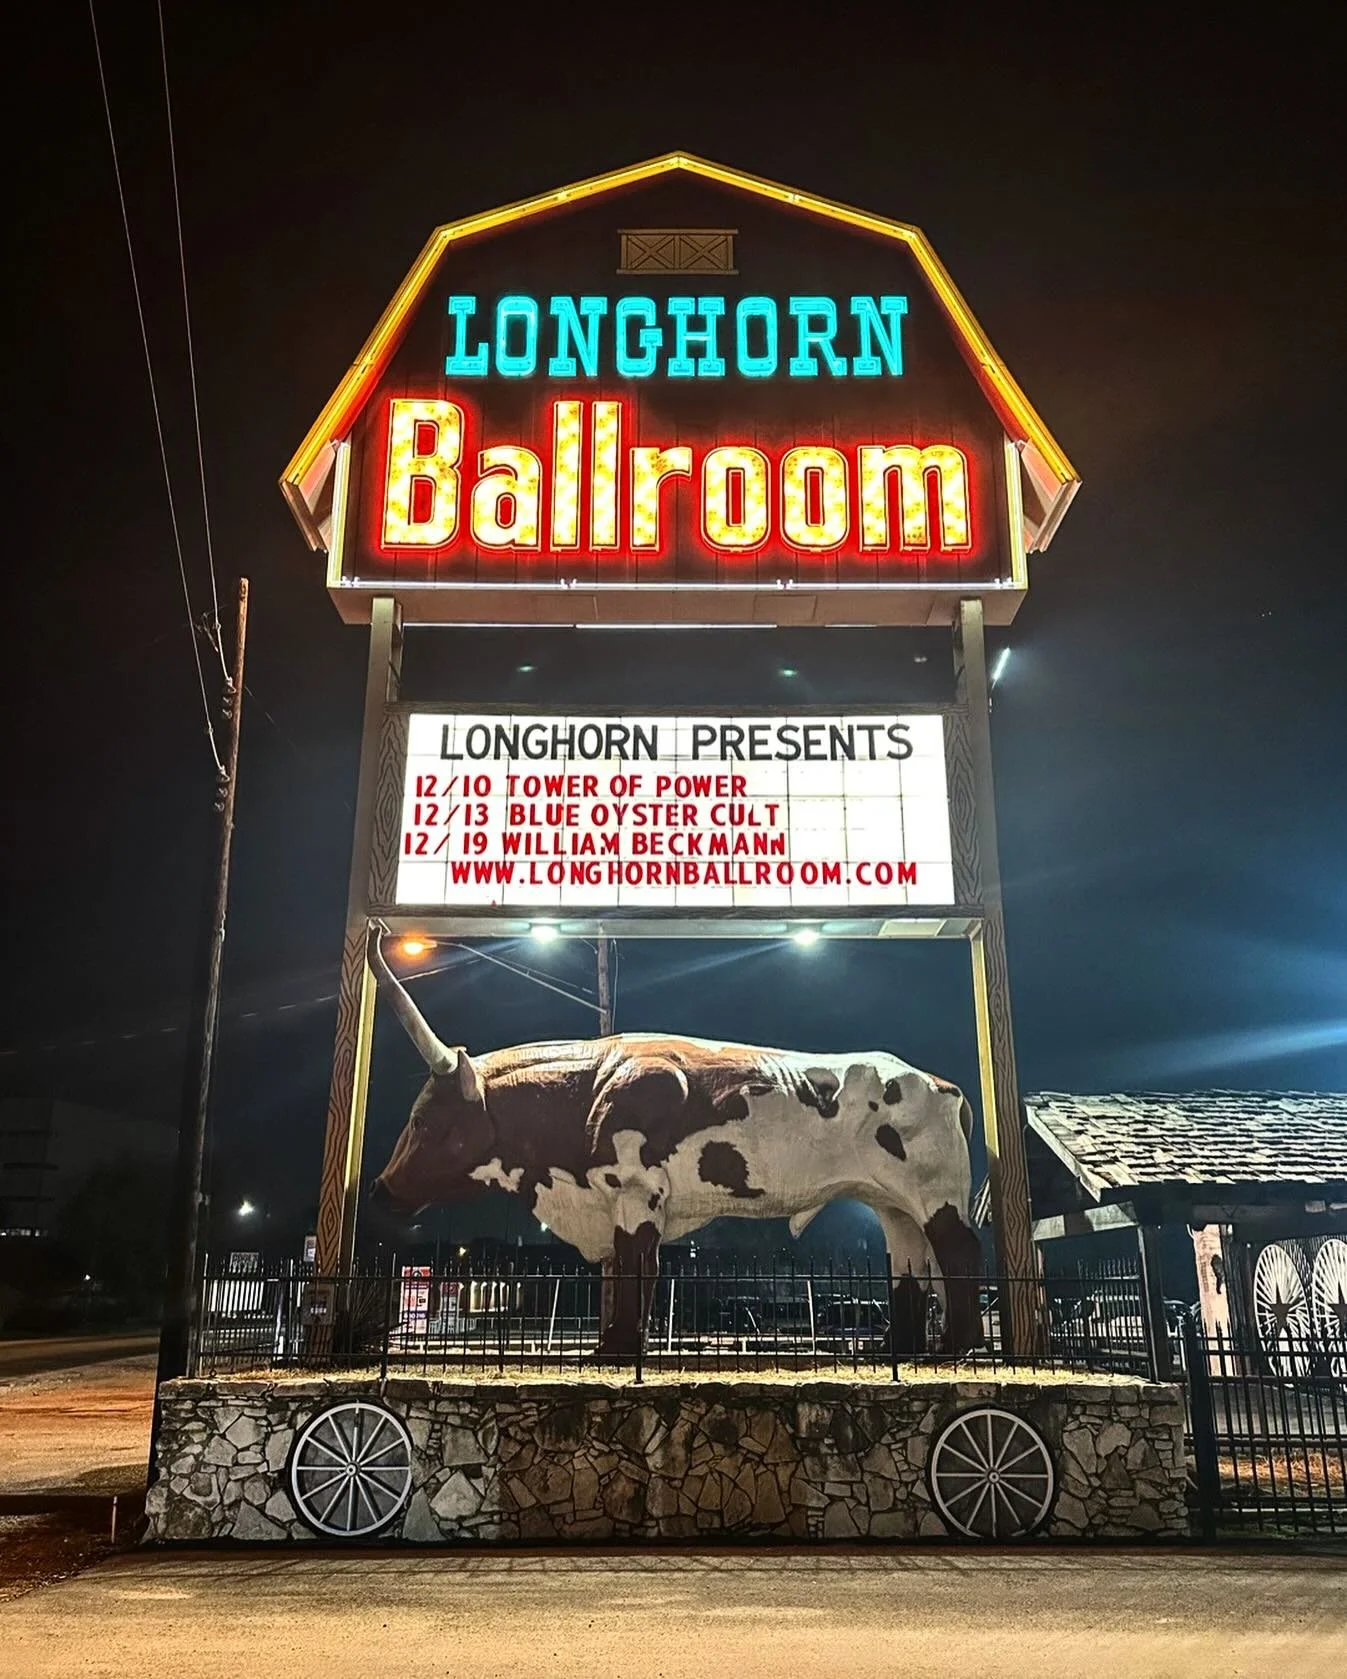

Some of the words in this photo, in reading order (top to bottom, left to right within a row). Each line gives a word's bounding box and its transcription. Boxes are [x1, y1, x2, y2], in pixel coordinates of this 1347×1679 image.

[445, 296, 908, 377] LONGHORN
[380, 398, 973, 553] Ballroom
[440, 724, 659, 760] LONGHORN
[691, 724, 914, 760] PRESENTS
[415, 775, 492, 798] 12/10
[507, 775, 598, 797] TOWER
[609, 775, 643, 797] OF
[655, 775, 747, 797] POWER
[414, 803, 489, 827] 12/13
[510, 803, 579, 827] BLUE
[591, 803, 698, 827] OYSTER
[710, 803, 780, 826] CULT
[502, 831, 620, 856] WILLIAM
[632, 831, 785, 856] BECKMANN
[451, 860, 917, 886] WWW.LONGHORNBALLROOM.COM
